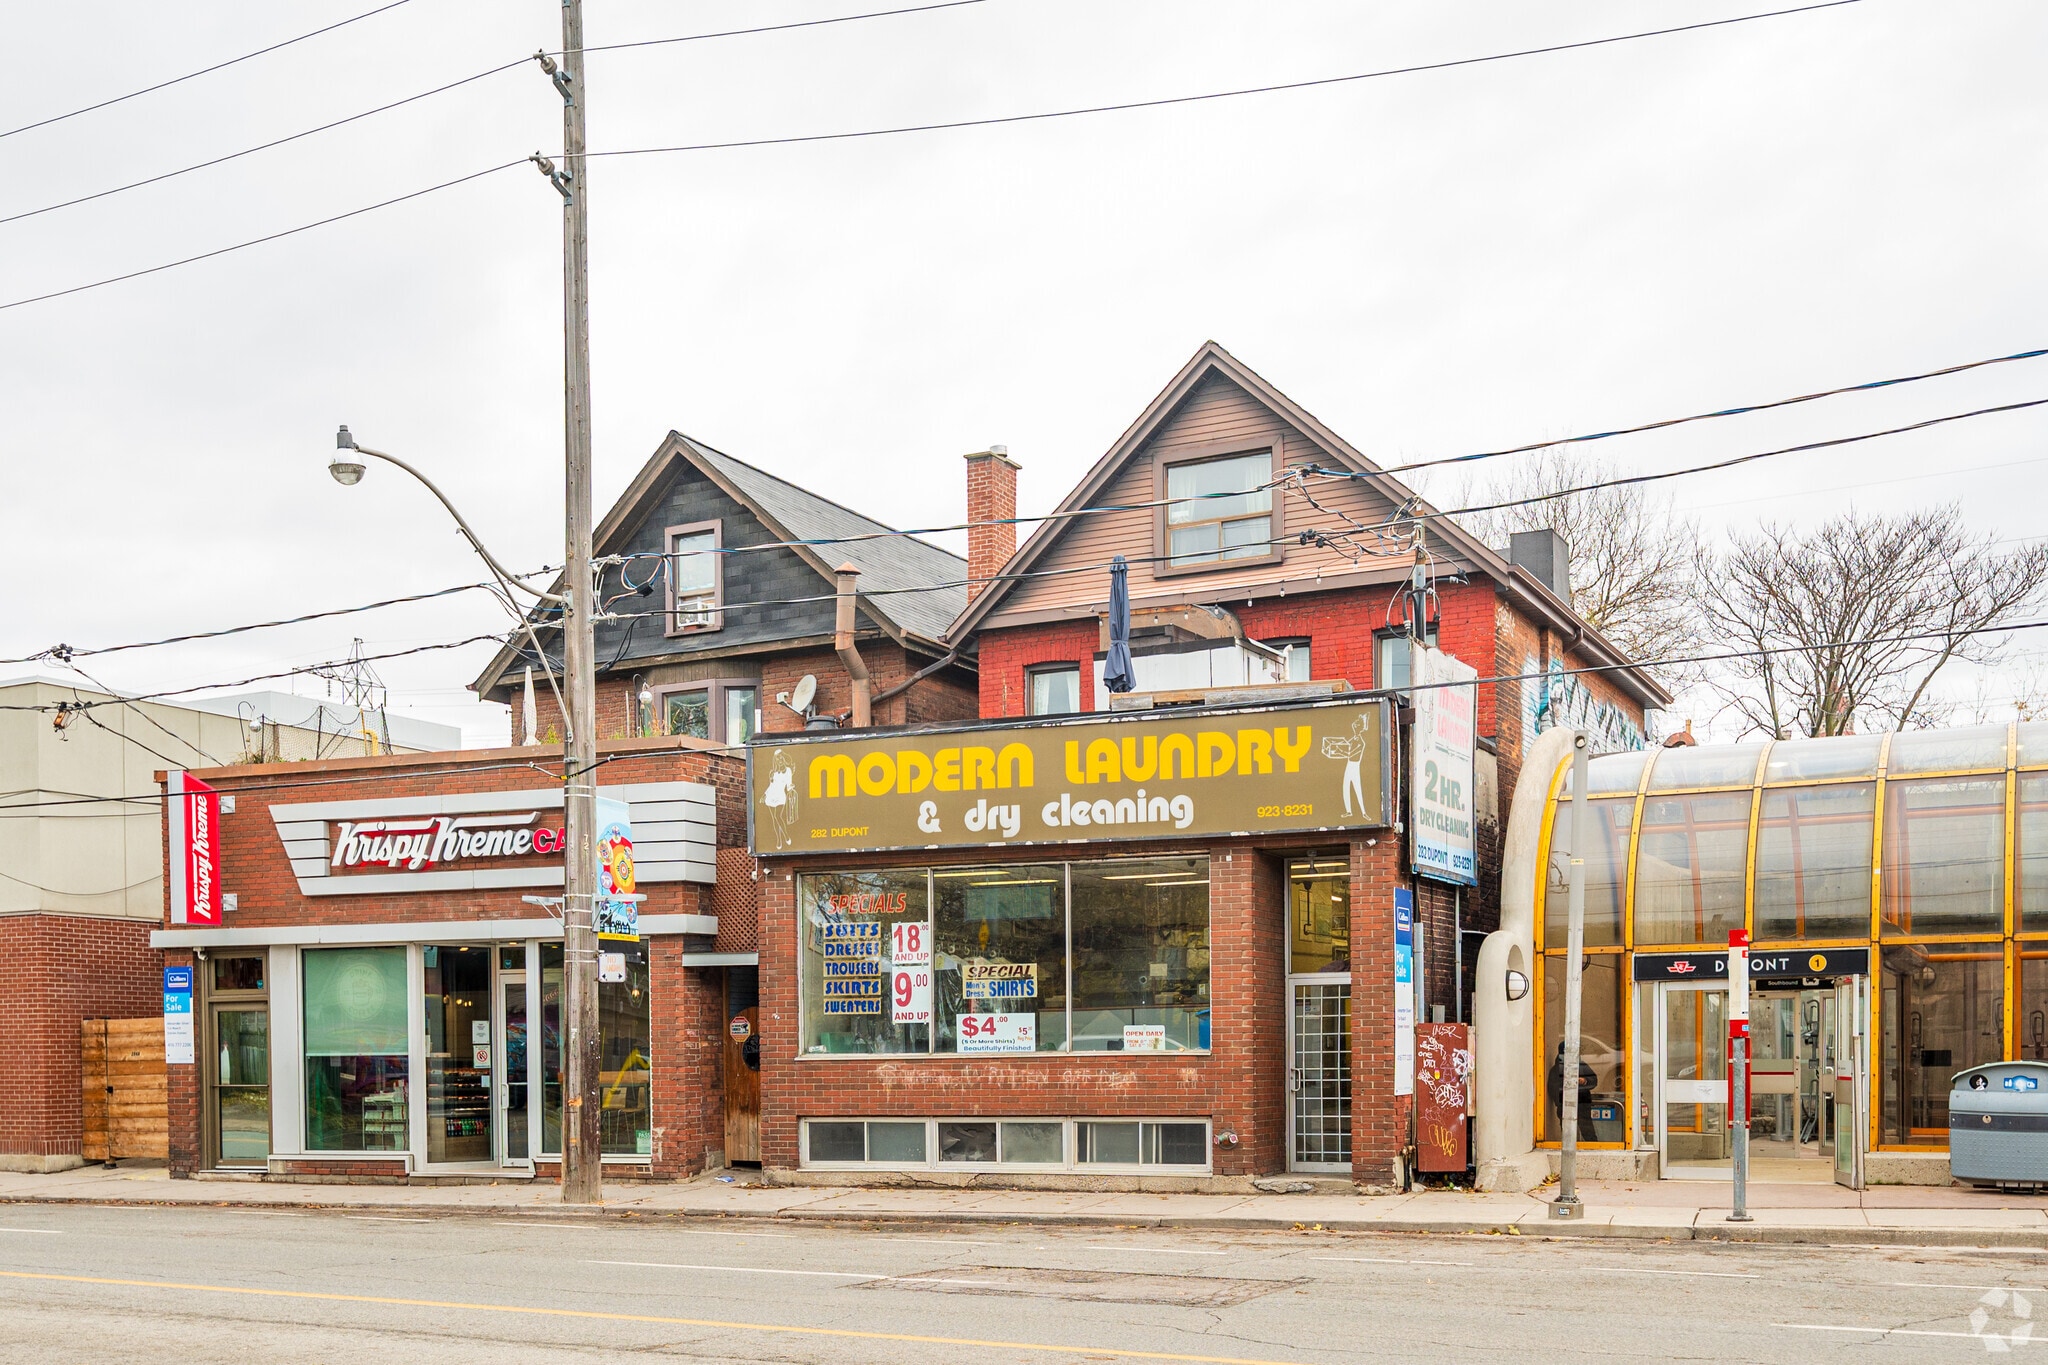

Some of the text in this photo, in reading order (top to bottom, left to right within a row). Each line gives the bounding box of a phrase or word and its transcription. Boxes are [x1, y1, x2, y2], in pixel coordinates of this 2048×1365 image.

[809, 725, 1312, 799] MODERN LAUNDRY
[1425, 759, 1465, 812] 2 HR.
[917, 788, 1194, 838] & dry cleaning
[1419, 806, 1469, 839] DRY CLEANING
[810, 826, 869, 839] 282 DUPONT
[331, 818, 437, 871] Krispy
[430, 811, 542, 862] Kreme
[191, 790, 213, 919] Krispy Kreme
[828, 892, 907, 915] SPECIALS
[825, 923, 879, 938] SUITS
[825, 942, 879, 956] DRESSES
[894, 952, 929, 962] AND UP
[825, 962, 879, 976] TROUSERS
[967, 965, 1032, 978] SPECIAL
[1714, 957, 1790, 973] DONT
[825, 981, 879, 995] SKIRTS
[965, 990, 985, 998] Dress
[989, 979, 1035, 997] SHIRTS
[165, 994, 178, 1003] For
[165, 1003, 182, 1011] Sale
[824, 1000, 880, 1013] SWEATERS
[894, 1012, 929, 1021] AND UP
[963, 1045, 1002, 1053] Beautifully
[1418, 1051, 1433, 1059] one
